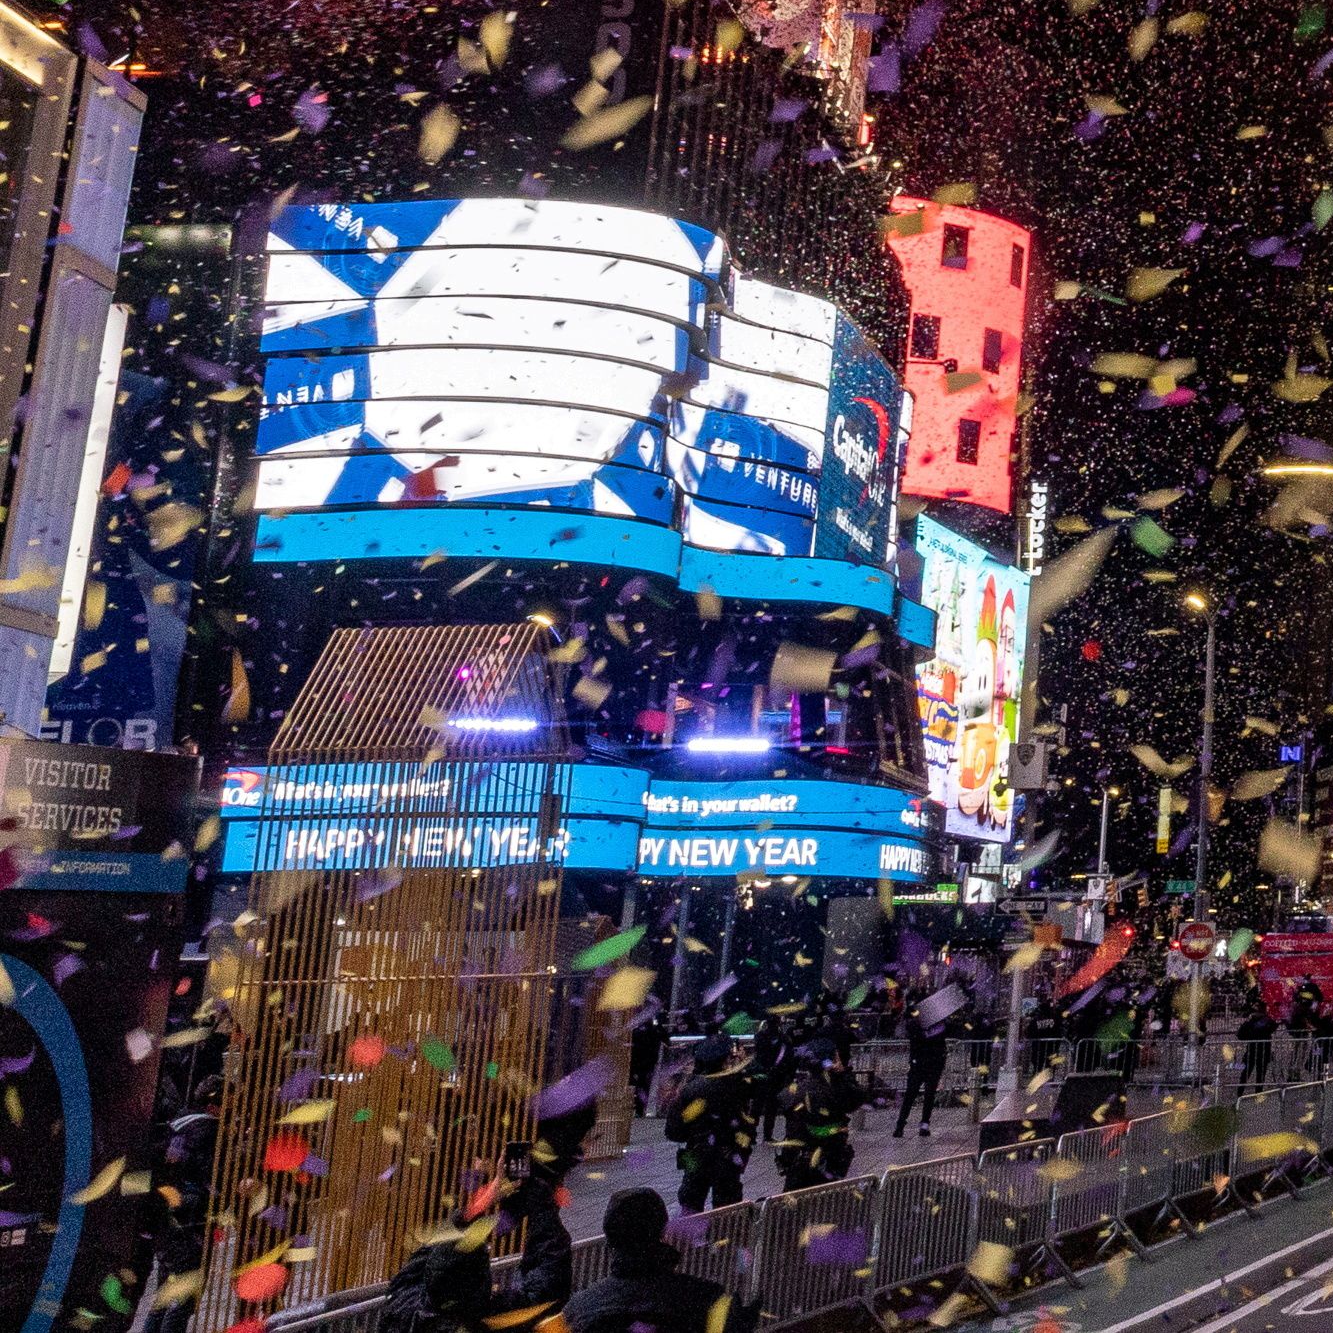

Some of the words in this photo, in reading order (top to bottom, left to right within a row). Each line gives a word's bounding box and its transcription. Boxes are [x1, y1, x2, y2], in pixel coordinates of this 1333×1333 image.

[24, 756, 113, 793] VISITOR
[16, 800, 123, 834] SERVICES
[700, 798, 738, 818] your
[738, 793, 798, 813] wallet?
[668, 839, 738, 867] NEW
[745, 837, 818, 866] YEAR
